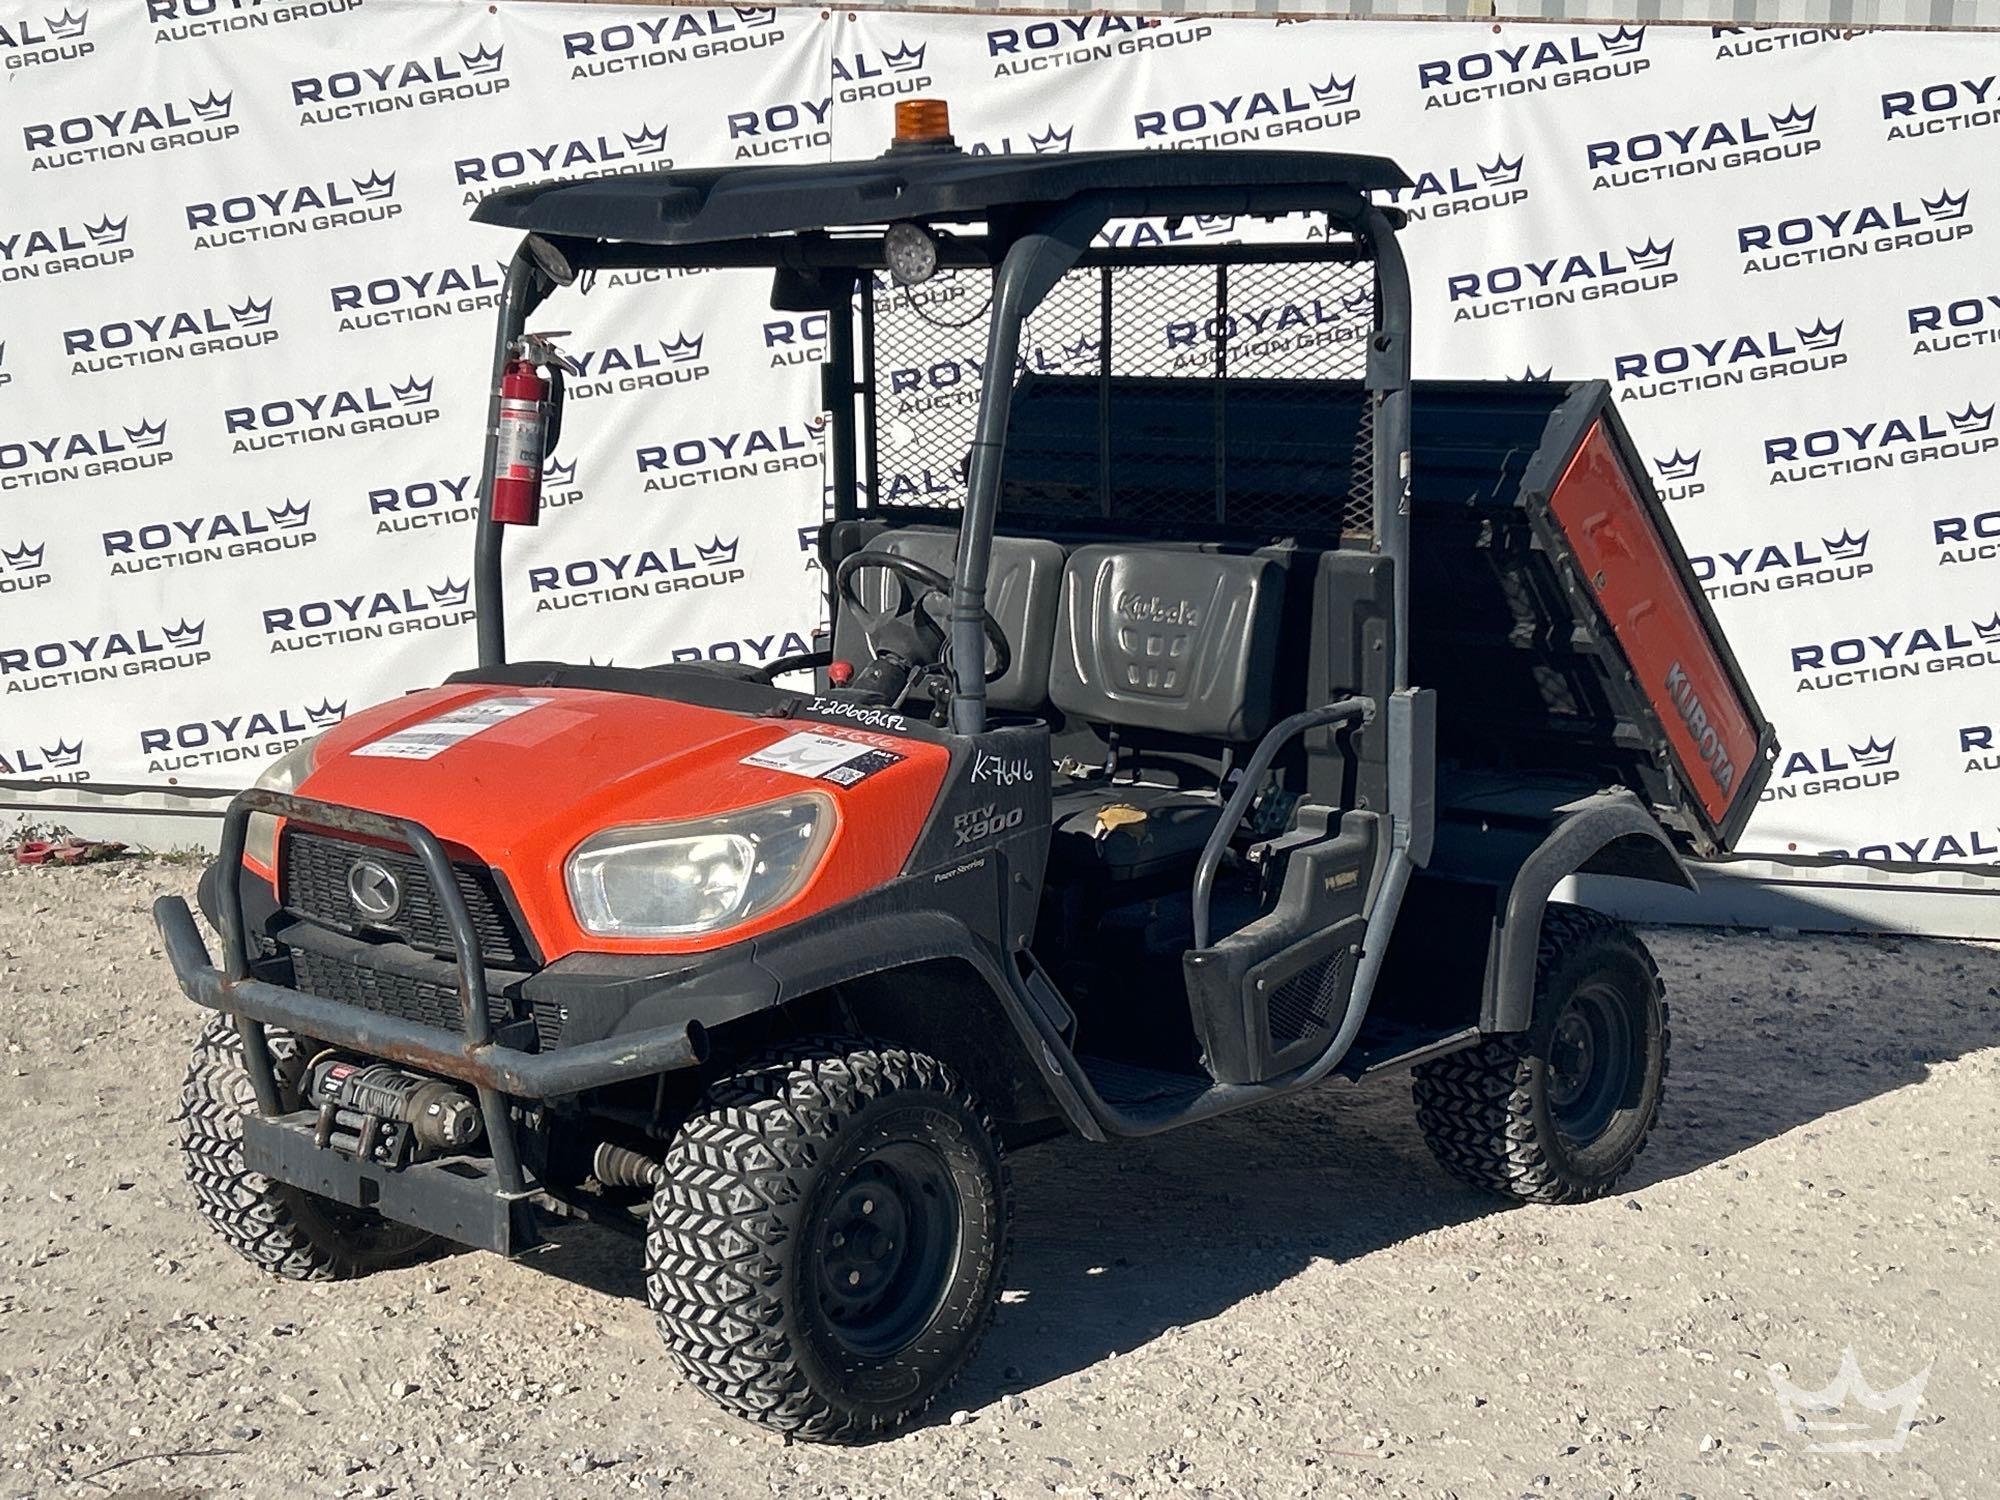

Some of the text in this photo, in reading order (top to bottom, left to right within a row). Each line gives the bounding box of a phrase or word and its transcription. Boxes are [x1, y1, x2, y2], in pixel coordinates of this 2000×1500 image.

[155, 12, 268, 44] AUCTION
[274, 0, 362, 23] GROUP
[563, 14, 735, 59] ROYAL
[1716, 28, 1840, 60] AUCTION
[6, 42, 94, 69] GROUP
[572, 30, 784, 80] AUCTION GROUP
[994, 26, 1212, 78] AUCTION GROUP
[1418, 37, 1598, 89] ROYAL
[292, 56, 461, 106] ROYAL
[300, 78, 510, 126] AUCTION GROUP
[840, 76, 932, 103] GROUP
[1425, 59, 1650, 110] AUCTION GROUP
[1882, 76, 2000, 120] ROY
[24, 103, 191, 151] ROYAL
[1134, 88, 1310, 140] ROYAL
[1266, 110, 1360, 138] GROUP
[32, 124, 239, 171] AUCTION GROUP
[454, 136, 624, 185] ROYAL
[1587, 117, 1769, 170] ROYAL
[1593, 140, 1820, 190] AUCTION GROUP
[186, 182, 354, 230] ROYAL
[1433, 190, 1528, 217] GROUP
[194, 204, 402, 250] AUCTION GROUP
[1738, 202, 1920, 253] ROYAL
[1744, 224, 1973, 274] AUCTION GROUP
[46, 248, 134, 274] GROUP
[1448, 251, 1626, 302] ROYAL
[330, 264, 498, 312] ROYAL
[1454, 273, 1678, 322] AUCTION GROUP
[64, 308, 230, 356] ROYAL
[339, 302, 452, 332] AUCTION
[72, 330, 278, 375] AUCTION GROUP
[1614, 332, 1796, 382] ROYAL
[1914, 329, 2000, 355] AUCTI
[619, 366, 709, 392] GROUP
[1620, 354, 1847, 402] AUCTION GROUP
[225, 388, 392, 434] ROYAL
[233, 410, 440, 454] AUCTION GROUP
[636, 426, 805, 472] ROYAL
[1764, 416, 1947, 464] ROYAL
[1770, 438, 1998, 485] AUCTION GROUP
[85, 452, 173, 476] GROUP
[644, 454, 824, 492] AUCTION GRO
[368, 476, 481, 514] ROY
[102, 511, 268, 556] ROYAL
[111, 532, 316, 576] AUCTION GROUP
[528, 548, 696, 592] ROYAL
[536, 569, 744, 612] AUCTION GROUP
[1776, 564, 1873, 590] GROUP
[263, 589, 428, 634] ROYAL
[270, 610, 476, 654] AUCTION GROUP
[0, 630, 164, 674] ROYAL
[1791, 624, 1972, 672] ROYAL
[6, 652, 210, 694] AUCTION GROUP
[1796, 662, 1920, 692] AUCTION
[140, 710, 306, 754] ROYAL
[1665, 660, 1734, 797] KUBOTA
[148, 745, 260, 773] AUCTION
[1804, 770, 1900, 795] GROUP
[954, 802, 996, 829] RTV
[954, 807, 1023, 848] X900
